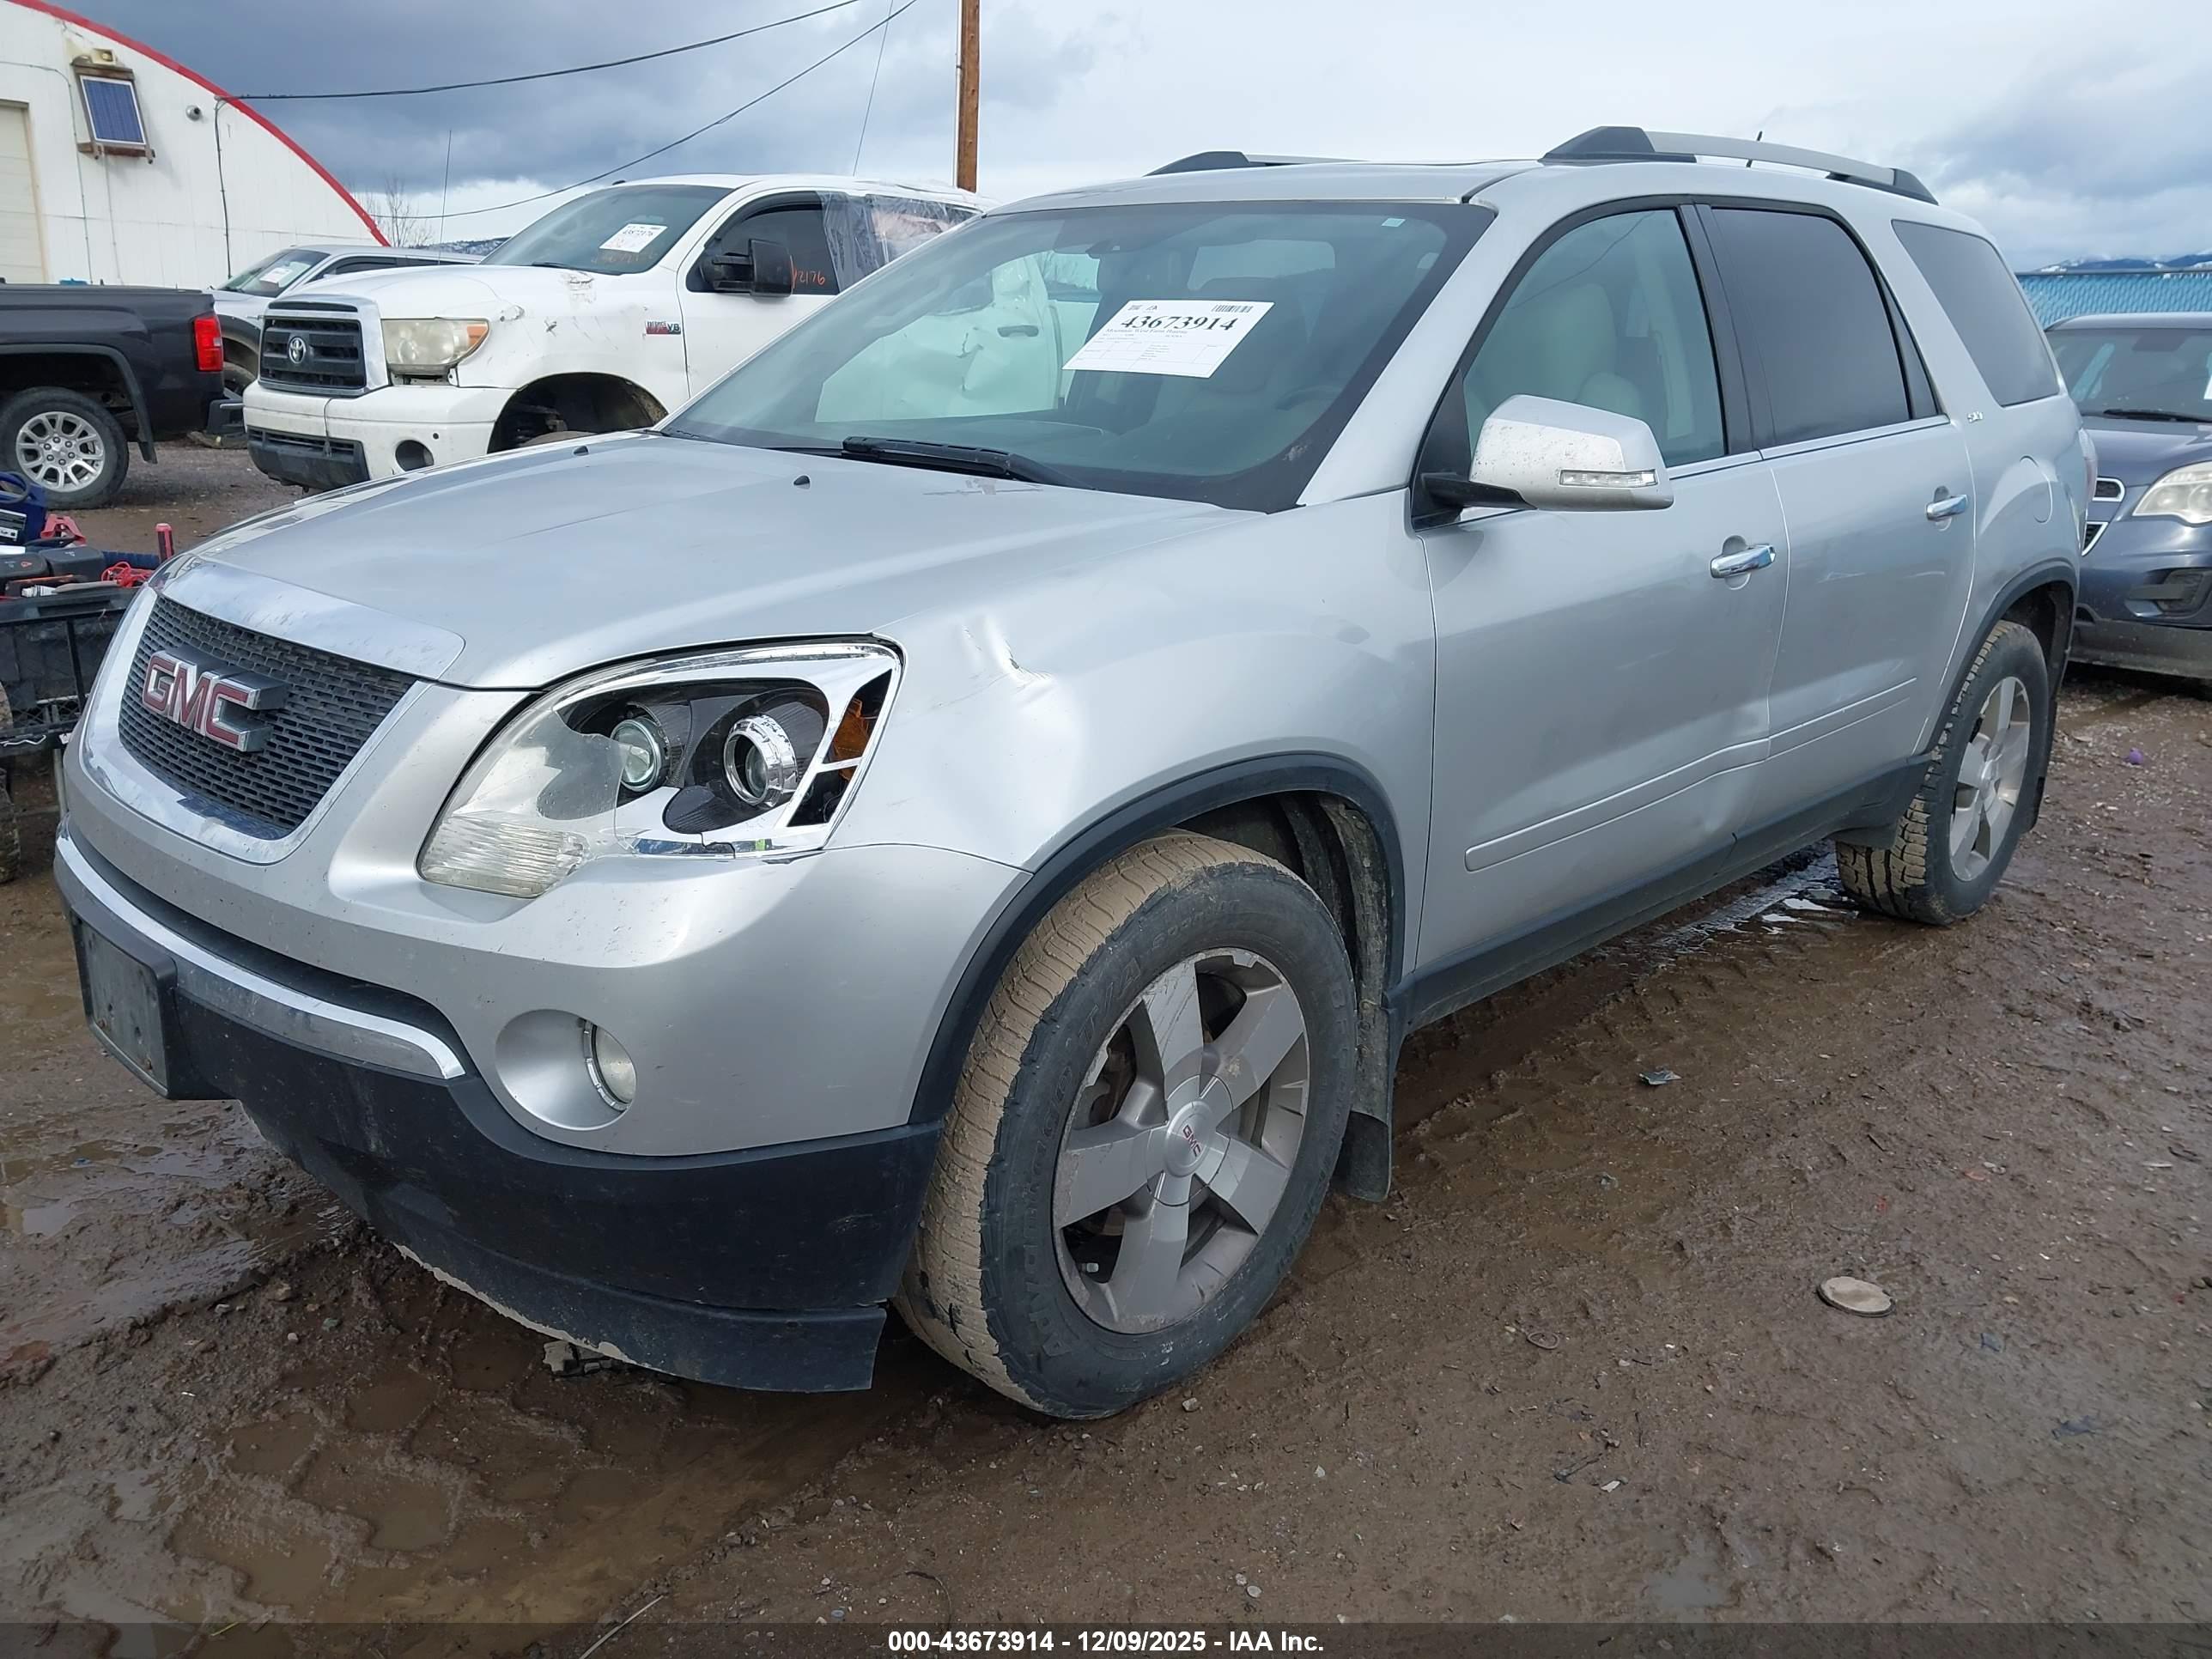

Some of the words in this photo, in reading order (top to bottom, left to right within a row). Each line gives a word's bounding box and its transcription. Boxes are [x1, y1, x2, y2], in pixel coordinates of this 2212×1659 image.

[1121, 315, 1240, 331] 43673914
[143, 649, 261, 752] GMC
[1182, 1124, 1201, 1158] GMC
